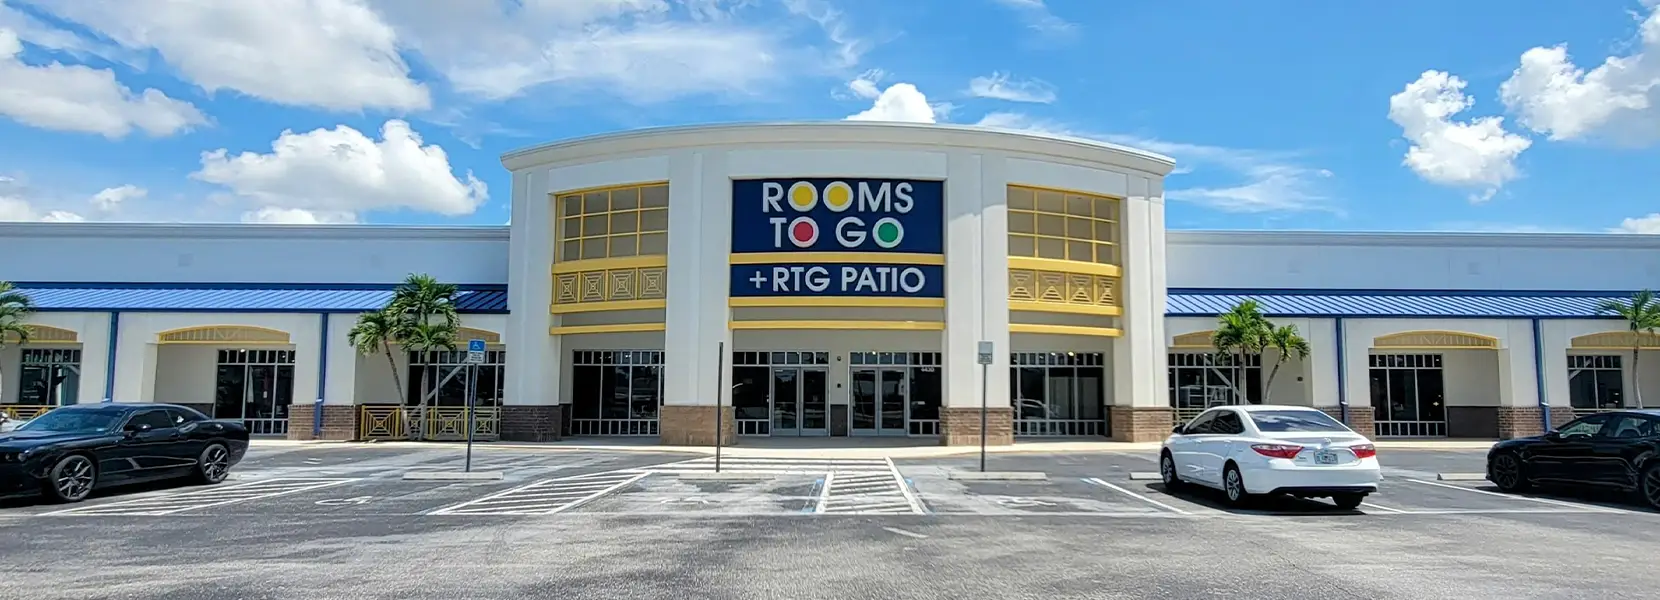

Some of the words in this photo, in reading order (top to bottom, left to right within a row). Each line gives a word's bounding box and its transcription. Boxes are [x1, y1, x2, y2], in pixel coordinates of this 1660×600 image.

[762, 180, 914, 214] ROOMS
[769, 216, 820, 248] TO
[835, 216, 905, 248] GO
[841, 266, 926, 293] PATIO
